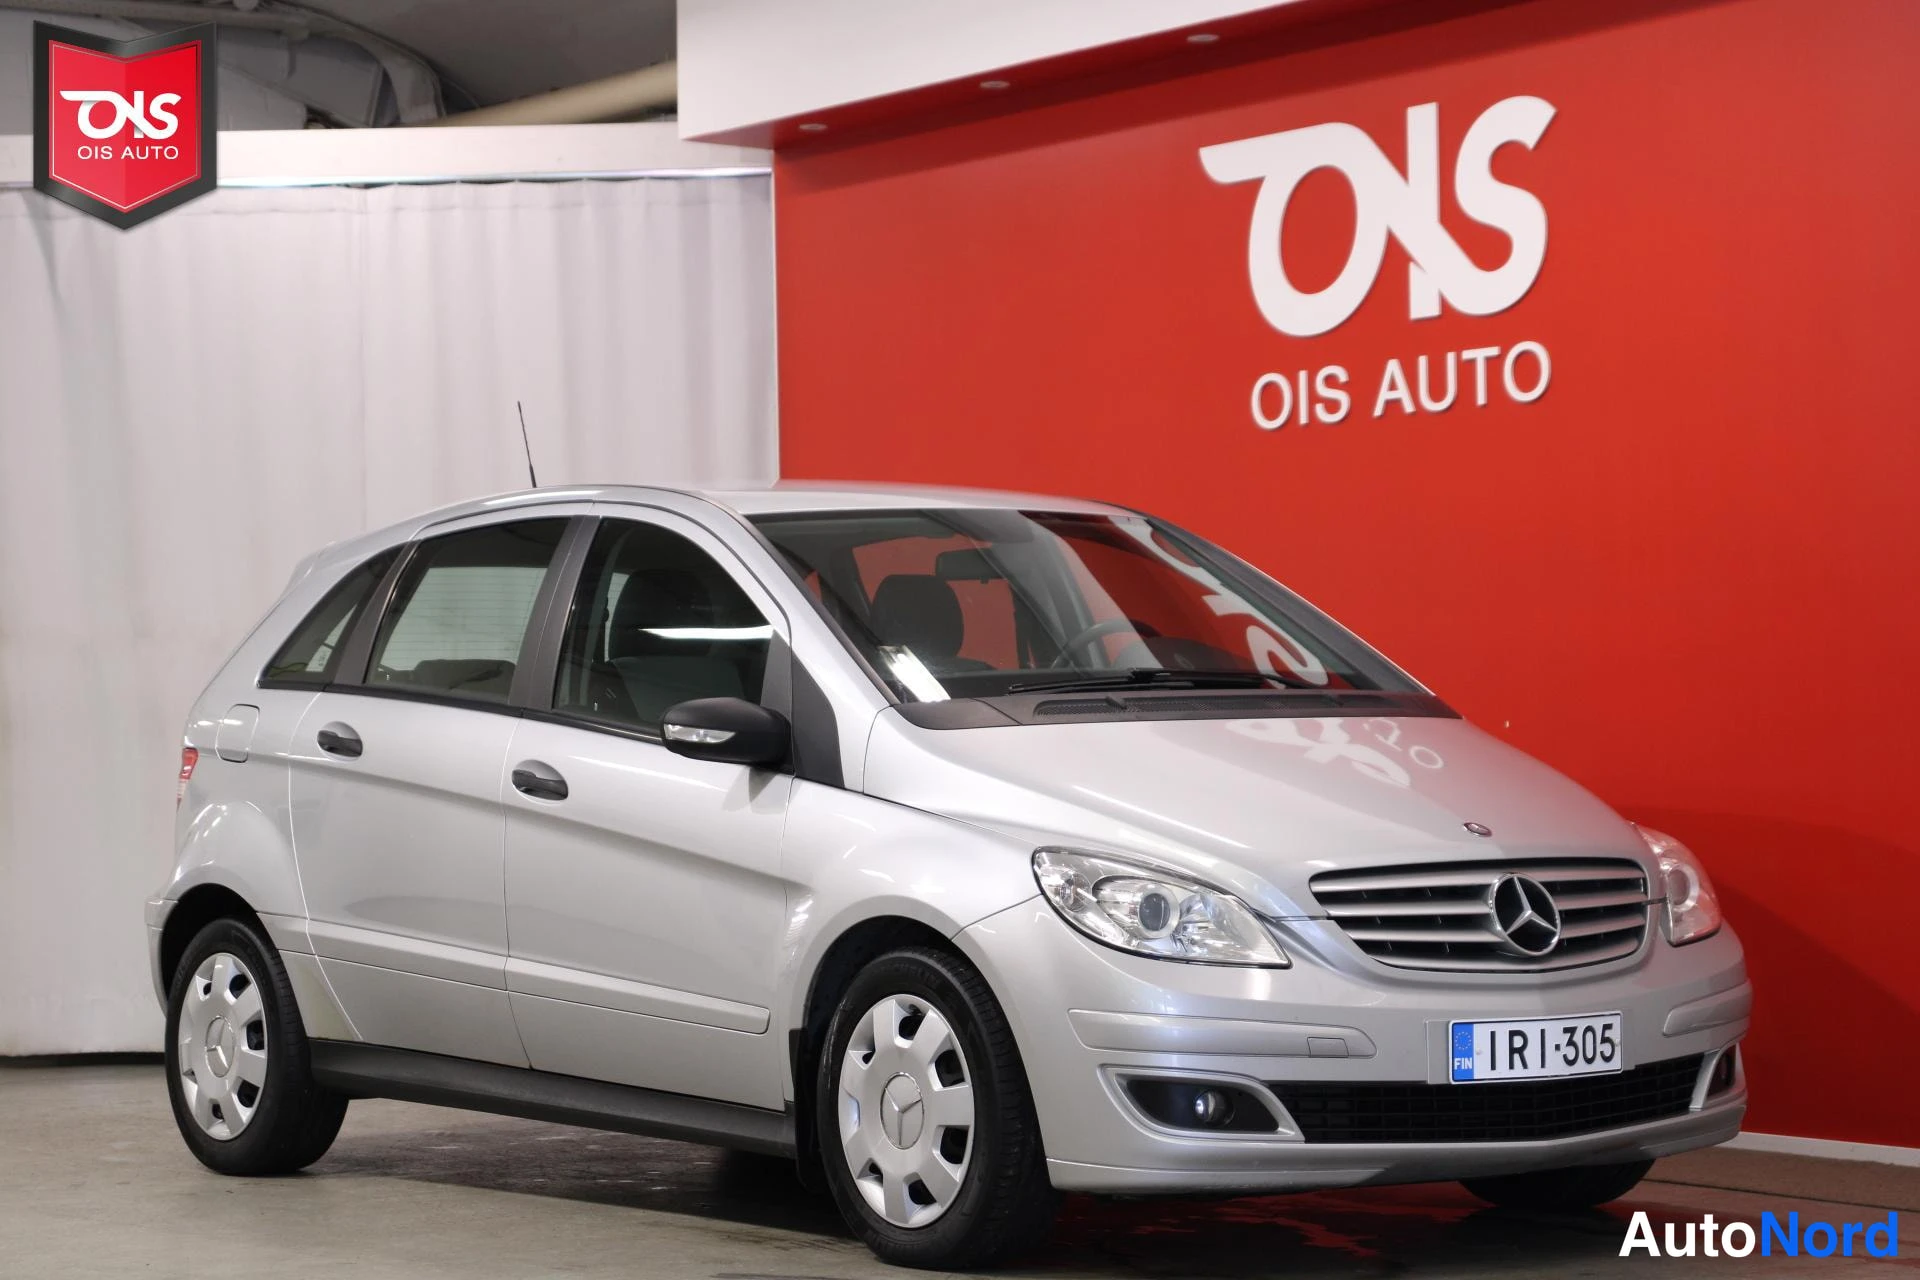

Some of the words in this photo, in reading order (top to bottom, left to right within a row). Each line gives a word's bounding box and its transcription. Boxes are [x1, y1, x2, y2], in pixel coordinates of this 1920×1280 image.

[1250, 364, 1351, 431] OIS
[1372, 340, 1552, 418] AUTO
[1454, 1057, 1473, 1070] FIN
[1489, 1022, 1617, 1071] IRI-305
